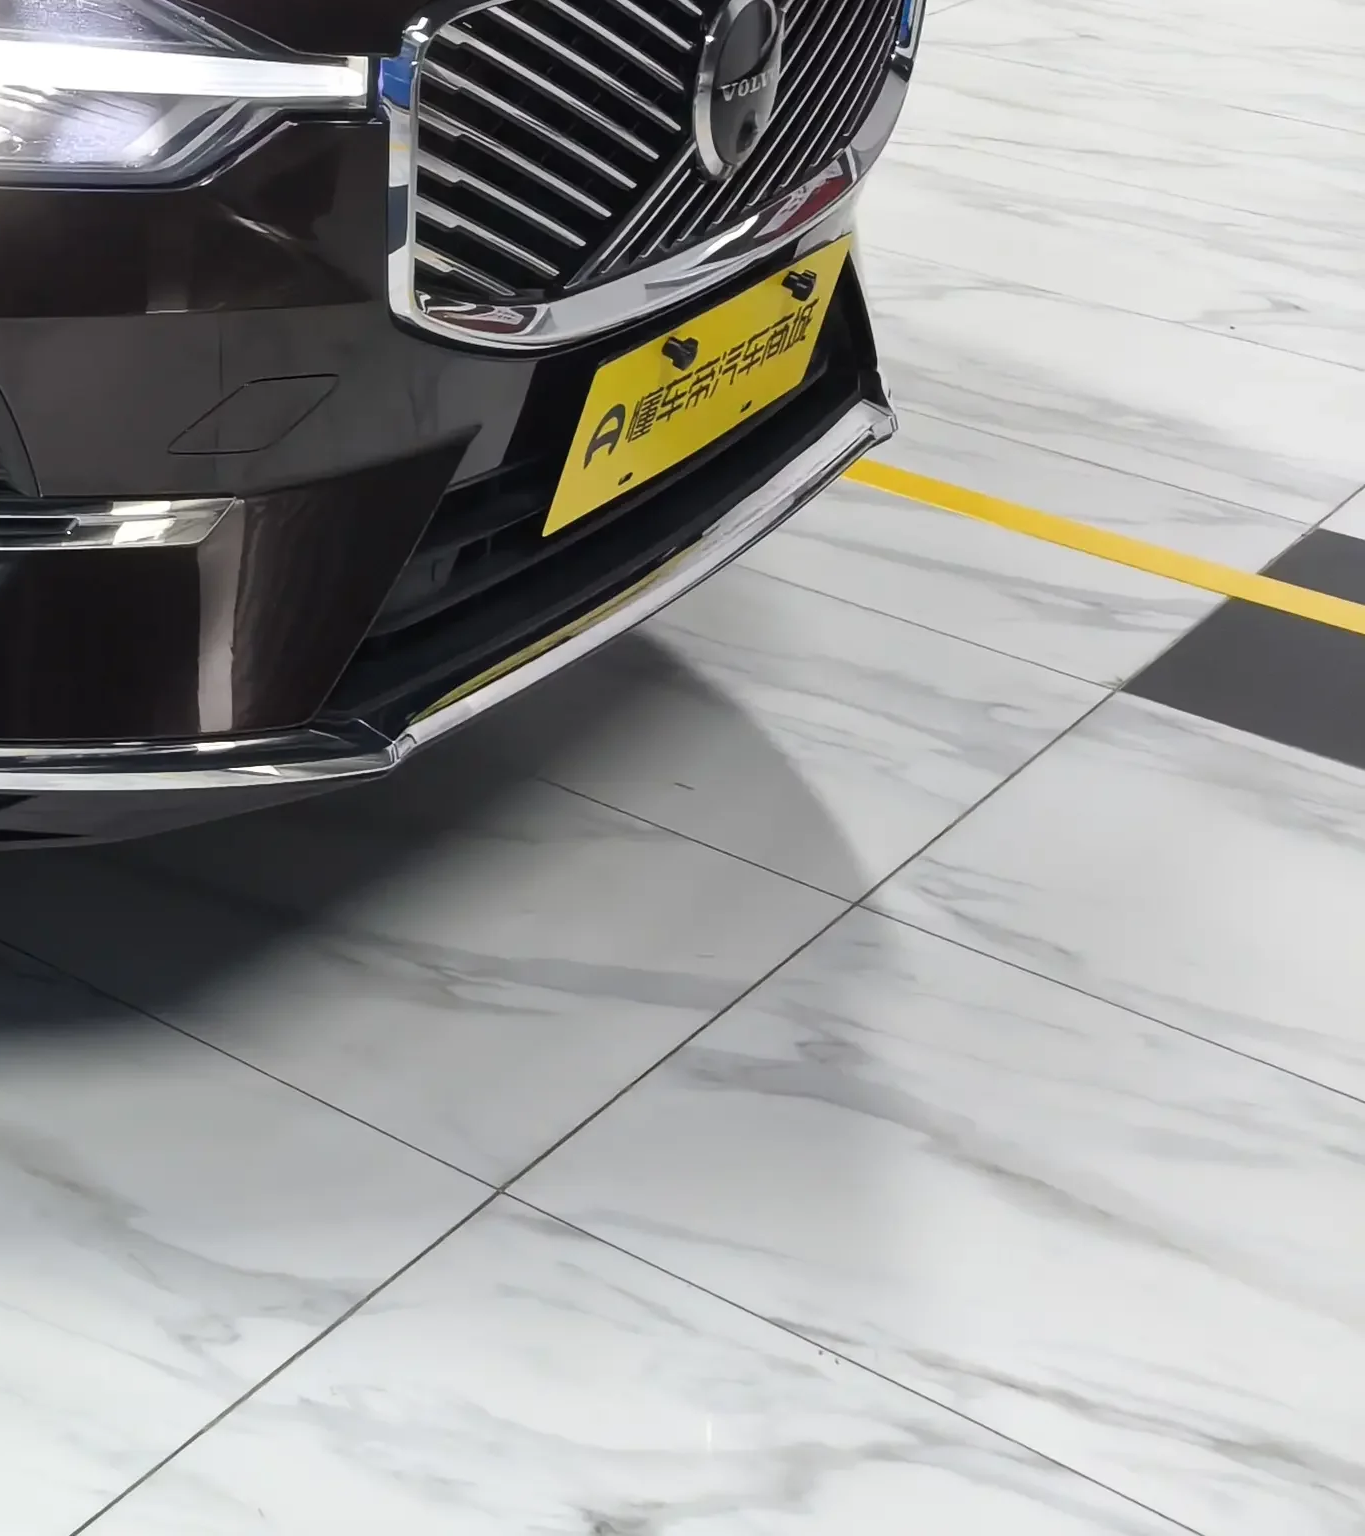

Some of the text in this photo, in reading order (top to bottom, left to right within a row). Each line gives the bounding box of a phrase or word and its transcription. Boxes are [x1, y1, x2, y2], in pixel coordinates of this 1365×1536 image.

[720, 69, 775, 102] VOLV
[625, 297, 820, 444] 懂车帝汽车商城
